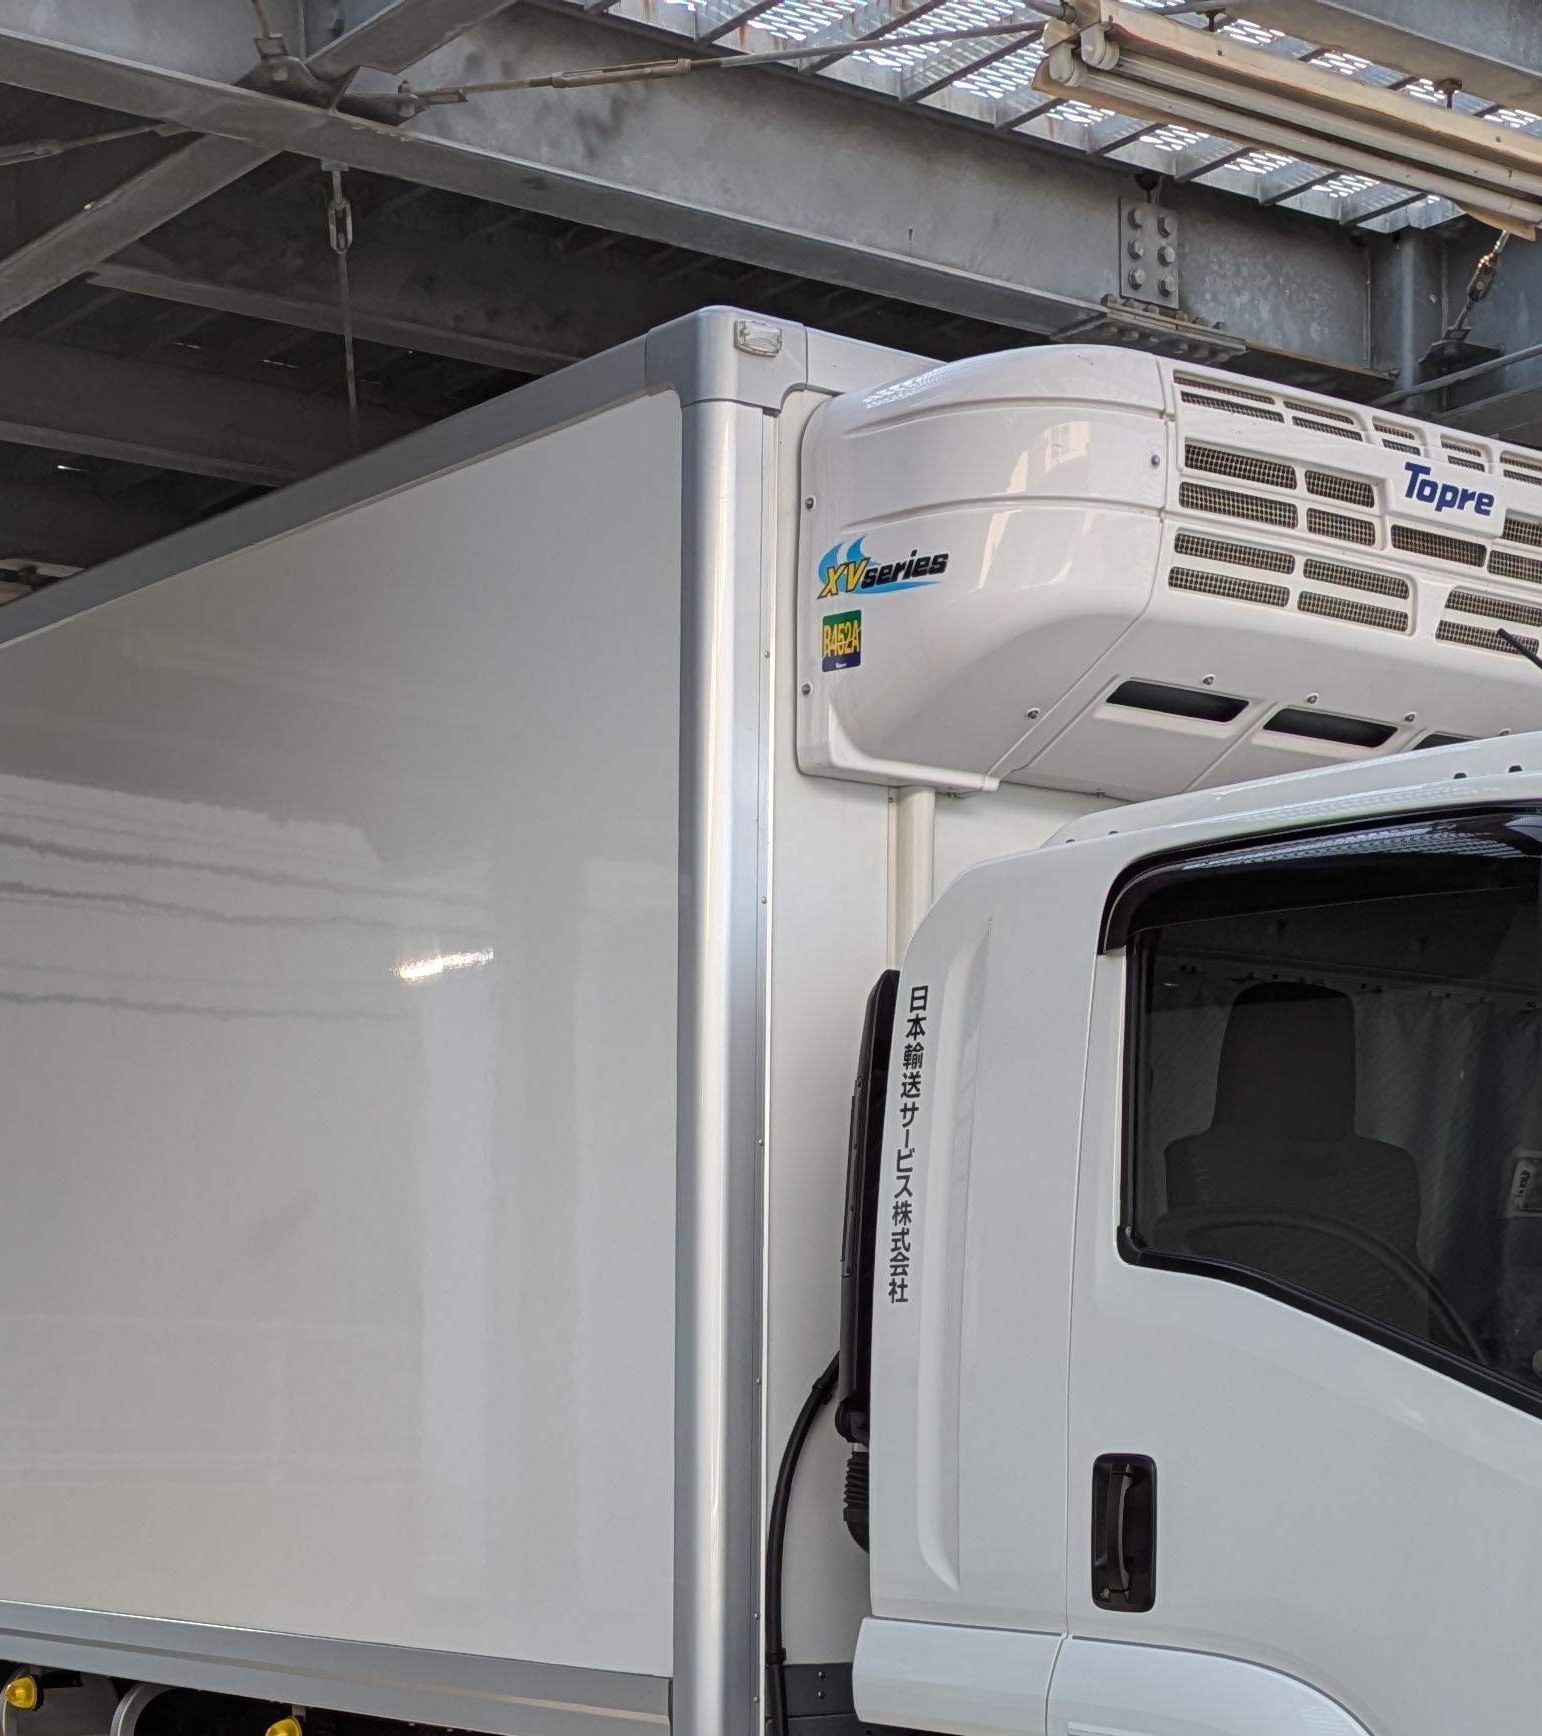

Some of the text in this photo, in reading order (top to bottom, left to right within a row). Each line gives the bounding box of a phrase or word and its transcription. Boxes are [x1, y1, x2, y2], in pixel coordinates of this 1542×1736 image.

[1404, 461, 1495, 517] Topre
[888, 985, 929, 1304] 日本輸送サービス株式会社
